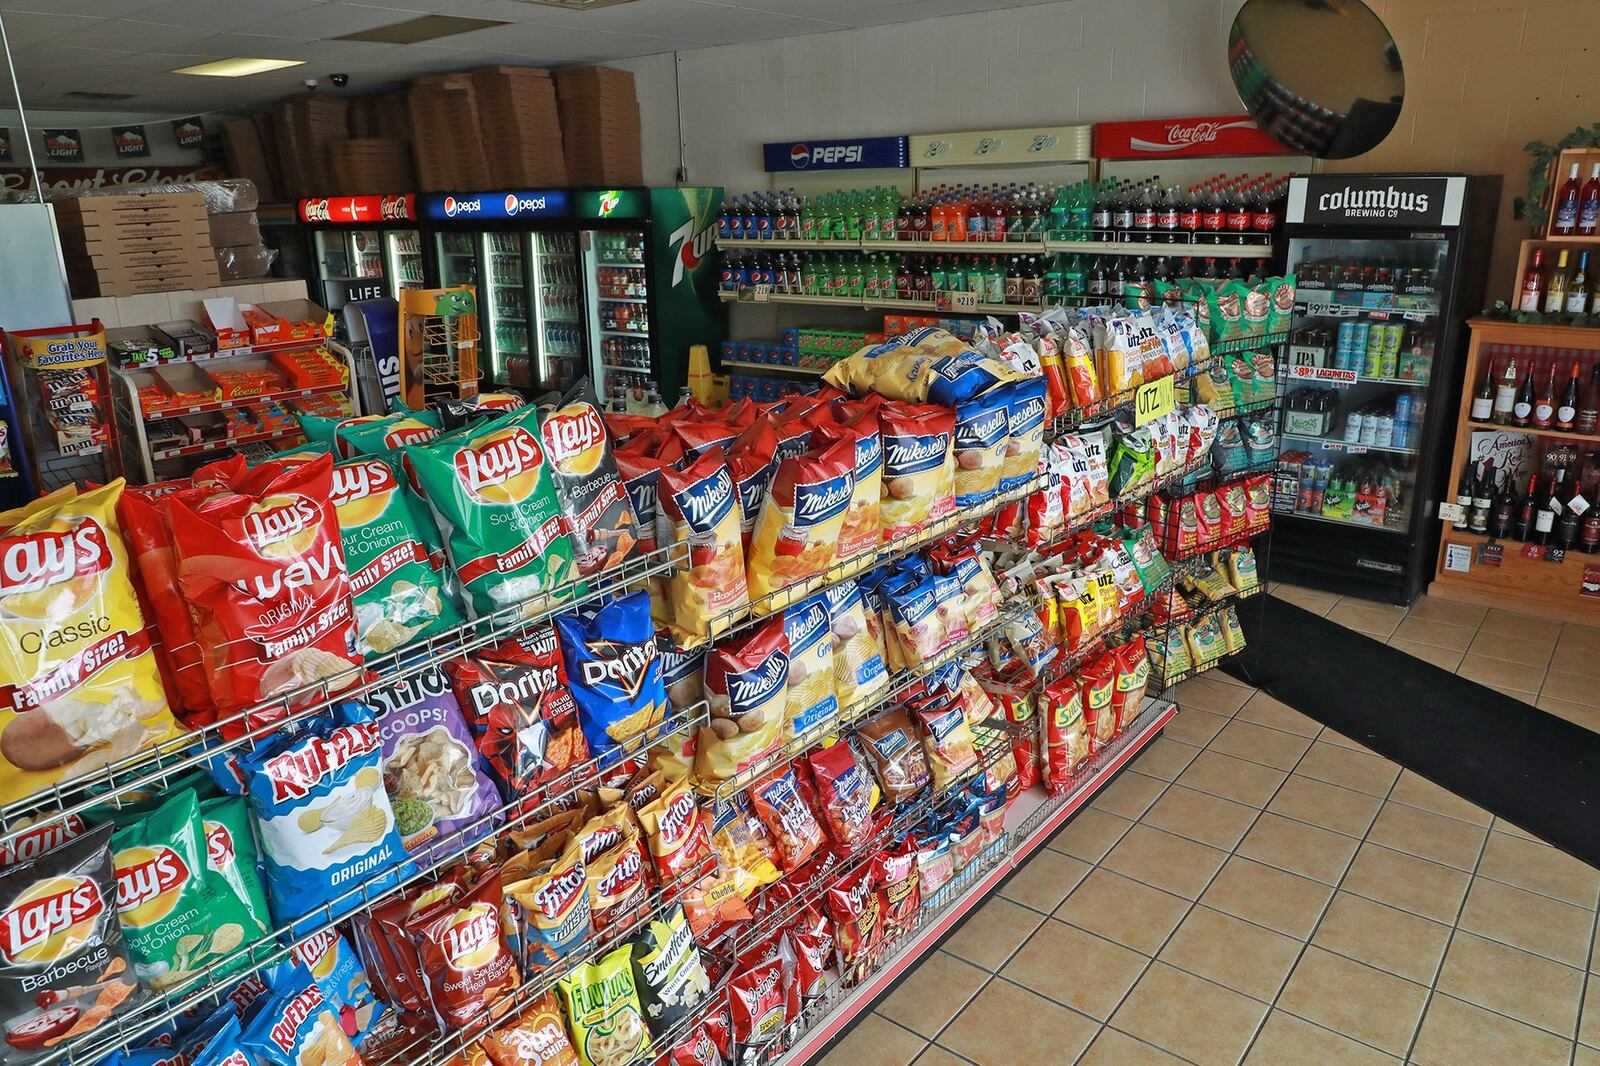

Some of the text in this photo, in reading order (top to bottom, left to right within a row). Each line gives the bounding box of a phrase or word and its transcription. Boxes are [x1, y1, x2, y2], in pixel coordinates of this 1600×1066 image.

[180, 134, 202, 144] LIGHT
[1168, 123, 1218, 143] Coca-Cola
[51, 148, 78, 157] LIGHT
[119, 144, 144, 152] LIGHT
[812, 145, 863, 164] PEPSI
[457, 199, 481, 214] pepsi
[519, 197, 546, 212] pepsi
[1319, 186, 1429, 213] columbus
[1345, 209, 1385, 217] BREWING
[350, 286, 381, 301] LIFE
[48, 340, 99, 354] Grab Your
[131, 349, 158, 362] TAKE 5
[37, 351, 86, 366] Favorites
[1295, 352, 1315, 367] IPA
[550, 410, 603, 461] Lay's
[462, 432, 533, 490] Lay's
[571, 472, 611, 499] Barbecue
[490, 495, 551, 526] Sour Cream
[510, 511, 548, 532] & Onion
[250, 500, 315, 549] Lay's
[361, 520, 404, 538] Cream
[349, 546, 358, 556] &
[357, 534, 396, 554] Onion
[497, 516, 560, 572] Family Size!
[382, 547, 415, 576] Size!
[20, 615, 111, 656] Classic
[266, 623, 317, 660] Family
[532, 636, 558, 657] WIN
[12, 632, 126, 710] Family Size!
[548, 694, 570, 710] NACHO
[551, 702, 575, 717] CHEESE
[803, 704, 835, 726] Original
[658, 789, 700, 843] Fritos
[331, 844, 393, 886] ORIGINAL
[534, 861, 587, 919] Fritos
[4, 883, 94, 956] Lay's
[155, 907, 199, 935] Cream
[141, 946, 151, 958] &
[150, 924, 190, 949] Onion
[450, 911, 497, 962] Lay's
[21, 947, 108, 993] Barbecue
[443, 975, 472, 993] Sweet
[466, 979, 488, 995] Heat
[269, 984, 325, 1058] RUFFLES
[541, 1036, 569, 1061] CHIPS
